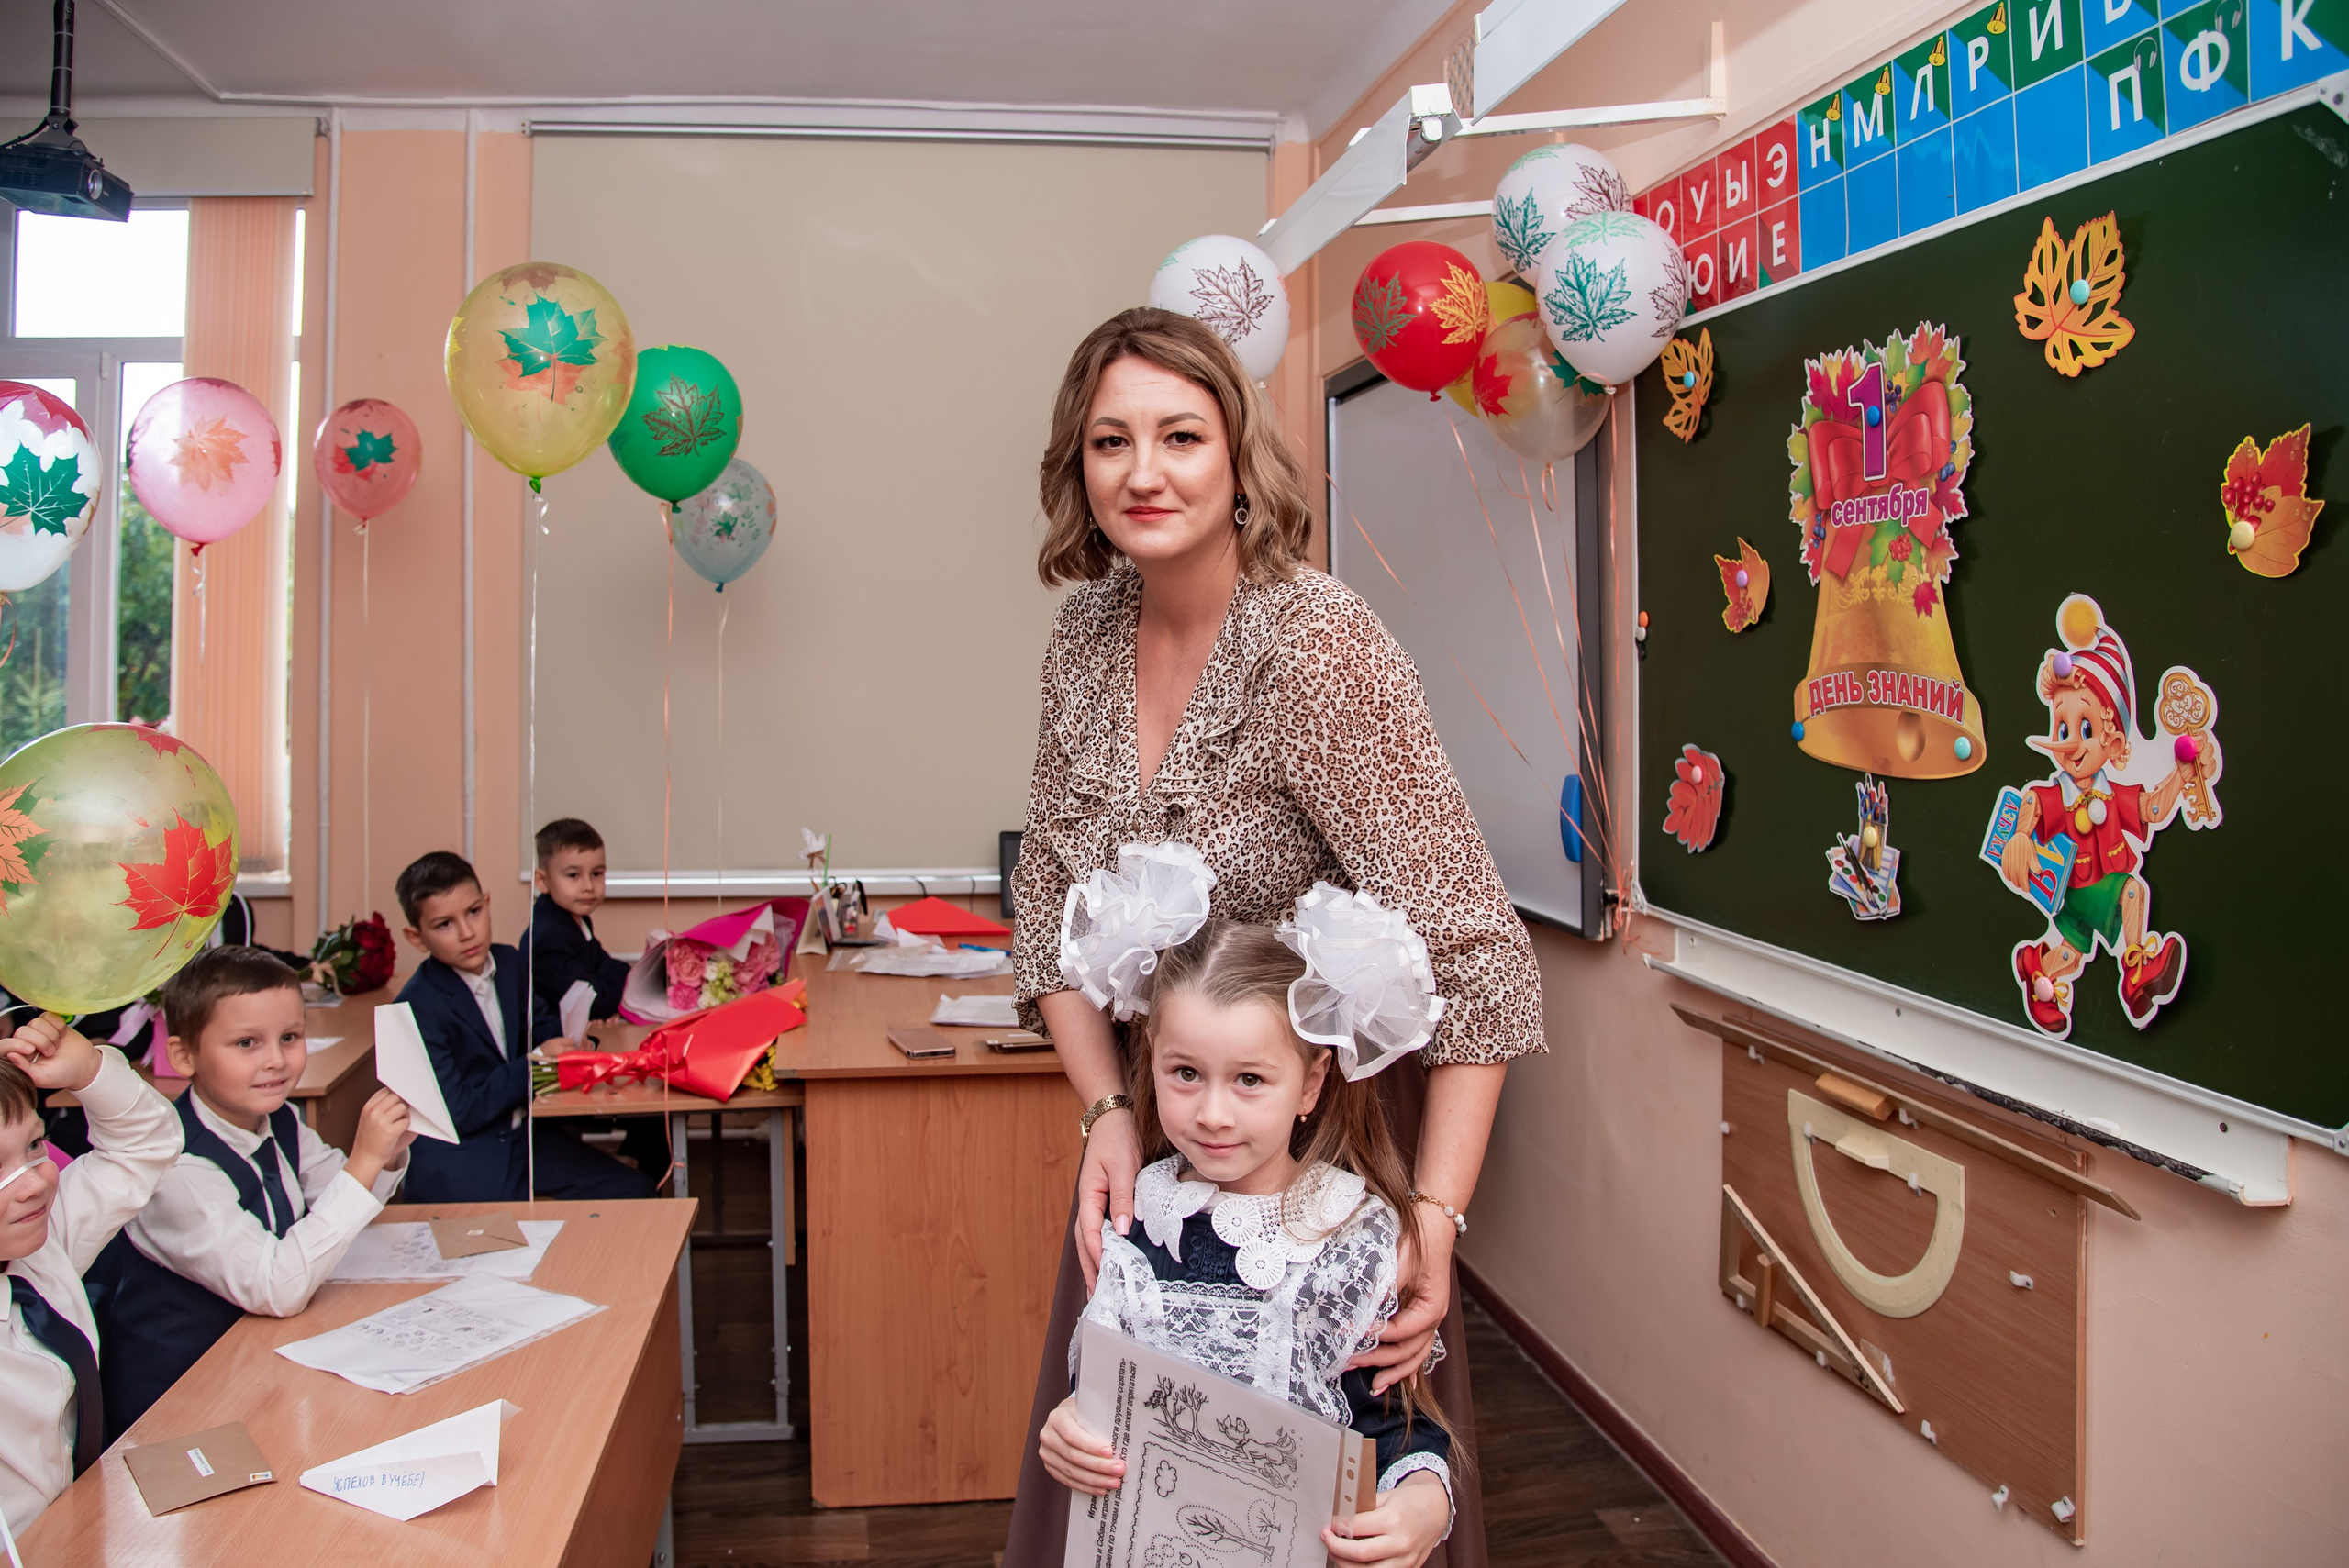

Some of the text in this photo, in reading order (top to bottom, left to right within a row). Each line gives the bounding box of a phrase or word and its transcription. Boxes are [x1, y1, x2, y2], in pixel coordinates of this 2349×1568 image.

[1690, 180, 1708, 224] У
[1726, 161, 1747, 209] Ы
[1766, 142, 1787, 188] Э
[1809, 117, 1831, 169] Н
[1853, 93, 1884, 148] М
[1910, 63, 1934, 120] Л
[1967, 36, 1989, 92] Р
[1687, 0, 2323, 299] Ю И Е П Ф К
[1848, 361, 1887, 481] 1
[1831, 483, 1929, 528] сентября
[1808, 670, 1965, 725] ДЕНЬ ЗНАНИЙ
[1987, 796, 2019, 858] АЗБУКА
[1127, 1361, 1137, 1407] спрятаться?
[1124, 1407, 1132, 1432] может
[1119, 1447, 1128, 1462] Кто
[1122, 1432, 1130, 1447] где
[333, 1474, 375, 1492] УСПЕХОВ
[1096, 1520, 1107, 1547] Собака
[1114, 1394, 1123, 1427] друзьям
[1087, 1494, 1098, 1519] Играе
[1109, 1507, 1119, 1533] точкам
[1105, 1545, 1114, 1568] дметы
[1108, 1534, 1115, 1545] по
